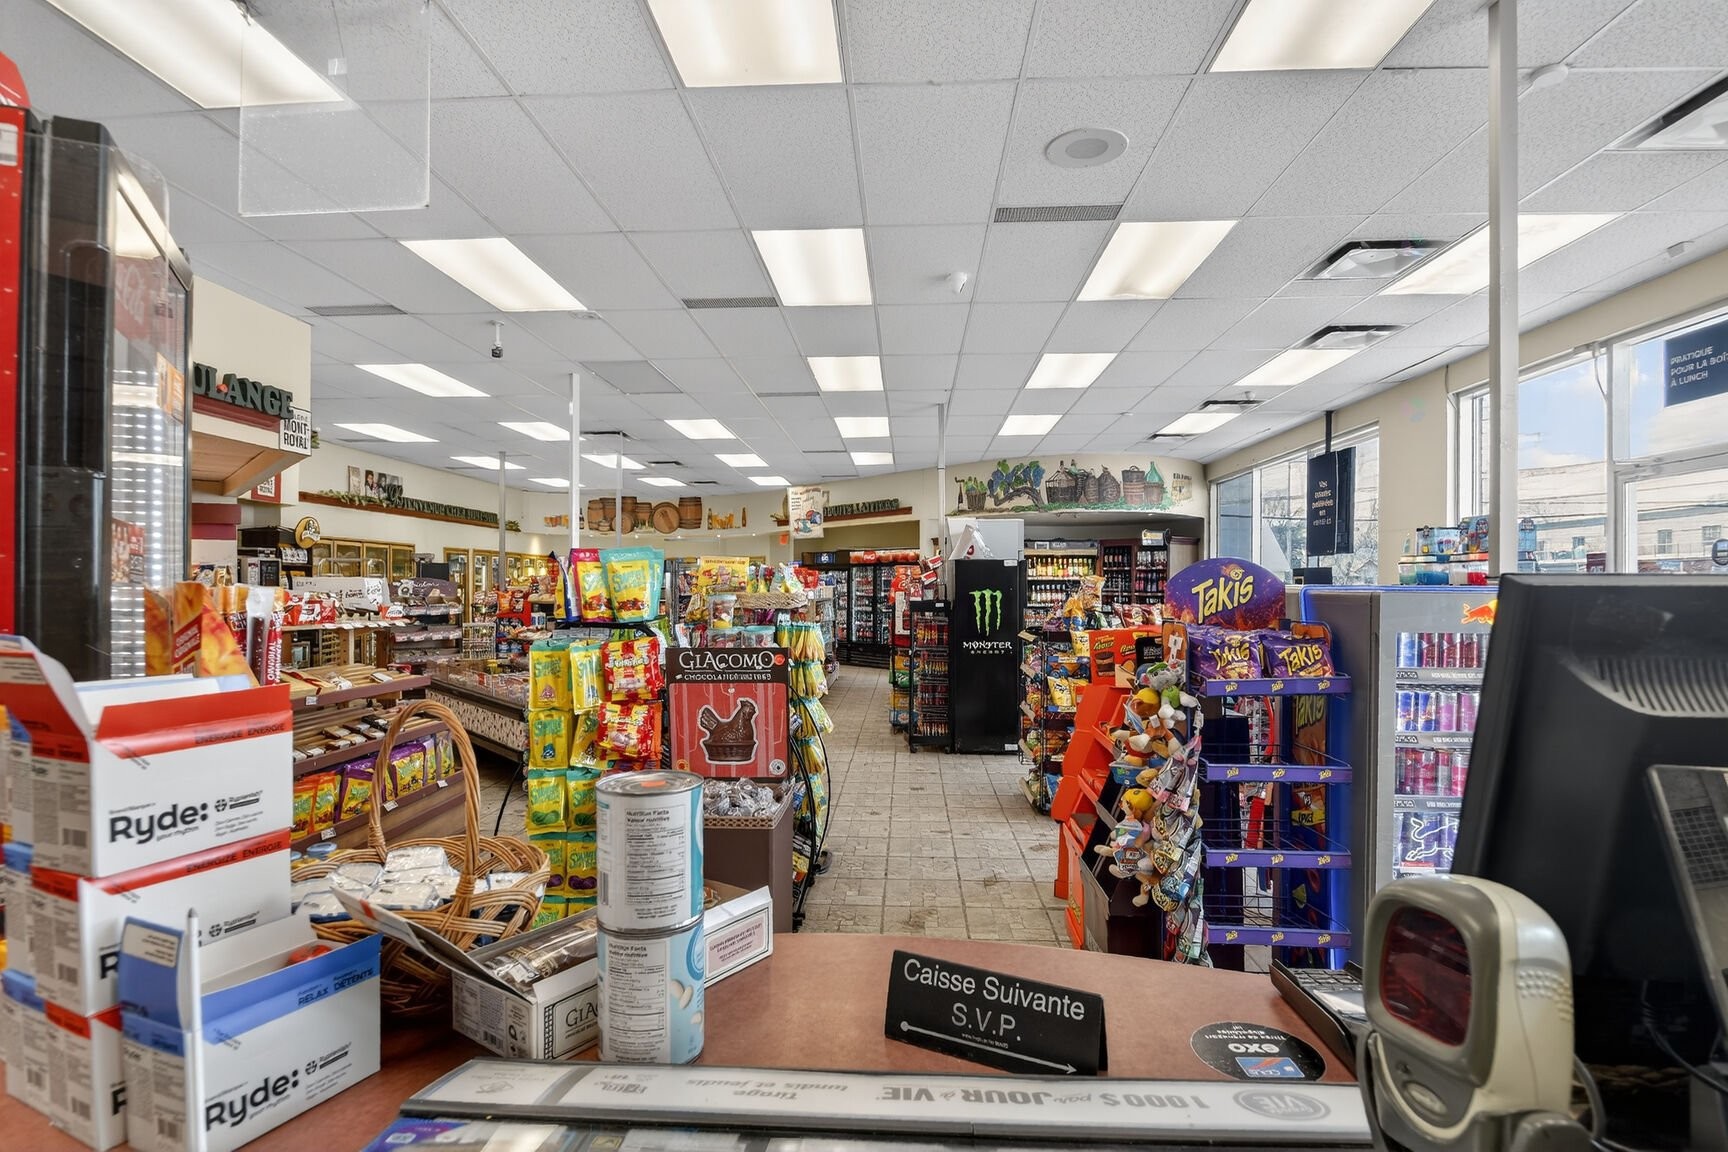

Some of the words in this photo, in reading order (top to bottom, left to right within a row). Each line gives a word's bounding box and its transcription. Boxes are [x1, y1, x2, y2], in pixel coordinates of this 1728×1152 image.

[1670, 346, 1713, 365] PRATIQUE
[1670, 363, 1695, 376] POUR
[1696, 359, 1707, 370] LA
[1678, 370, 1709, 385] LUNCH
[1192, 575, 1254, 625] Takis
[679, 650, 775, 672] GIACOMO
[1278, 644, 1323, 677] Takis
[904, 958, 976, 995] Caisse
[982, 976, 1085, 1021] Suivante
[951, 1002, 1021, 1041] S.V.P.
[1227, 1043, 1280, 1055] exo
[880, 1086, 935, 1103] VIE
[959, 1087, 1052, 1106] JOUR
